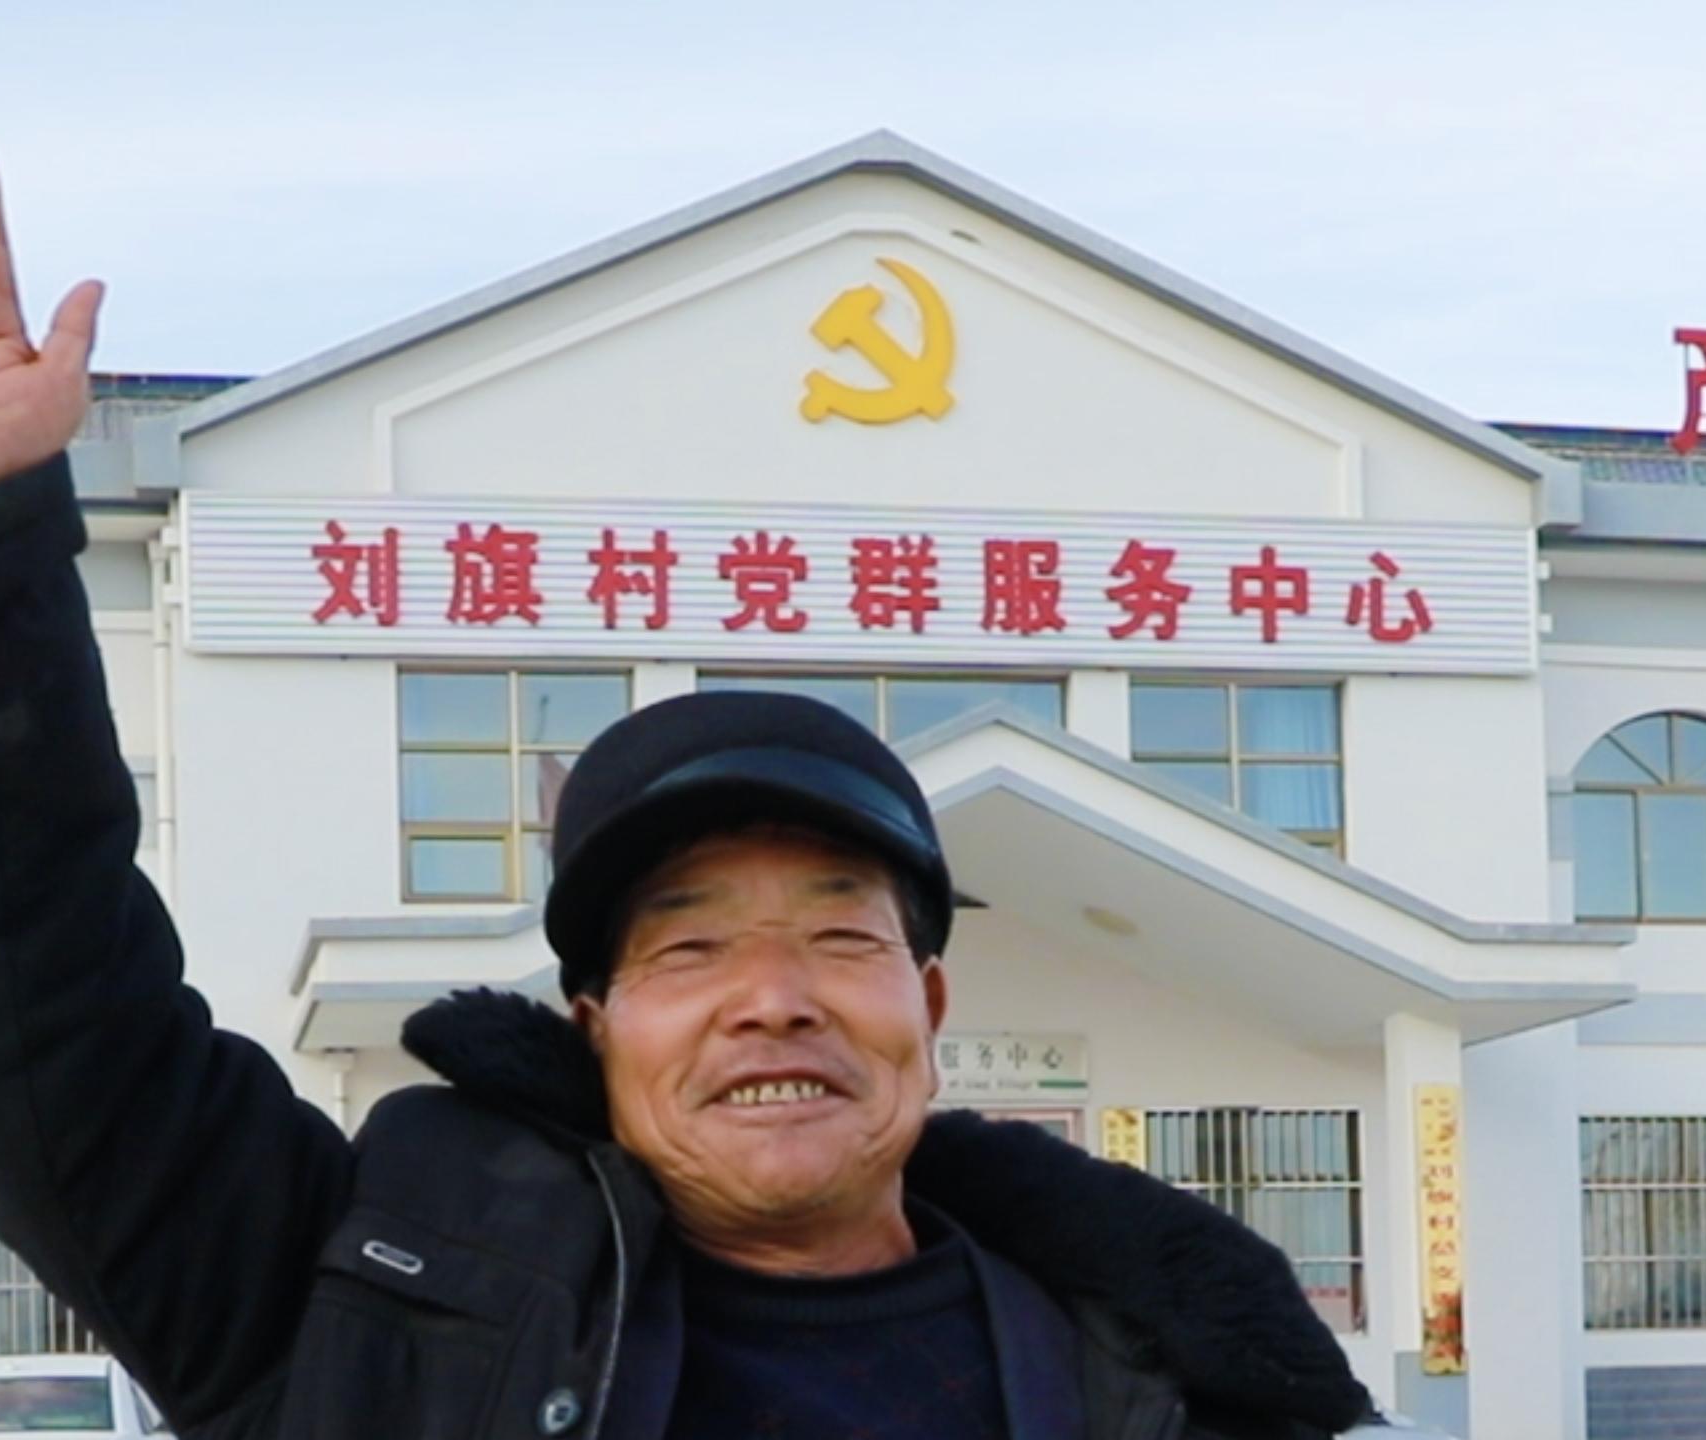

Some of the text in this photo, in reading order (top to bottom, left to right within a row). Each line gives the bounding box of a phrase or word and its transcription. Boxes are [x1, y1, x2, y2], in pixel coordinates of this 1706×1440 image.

[310, 519, 1434, 645] 刘旗村党群服务中心
